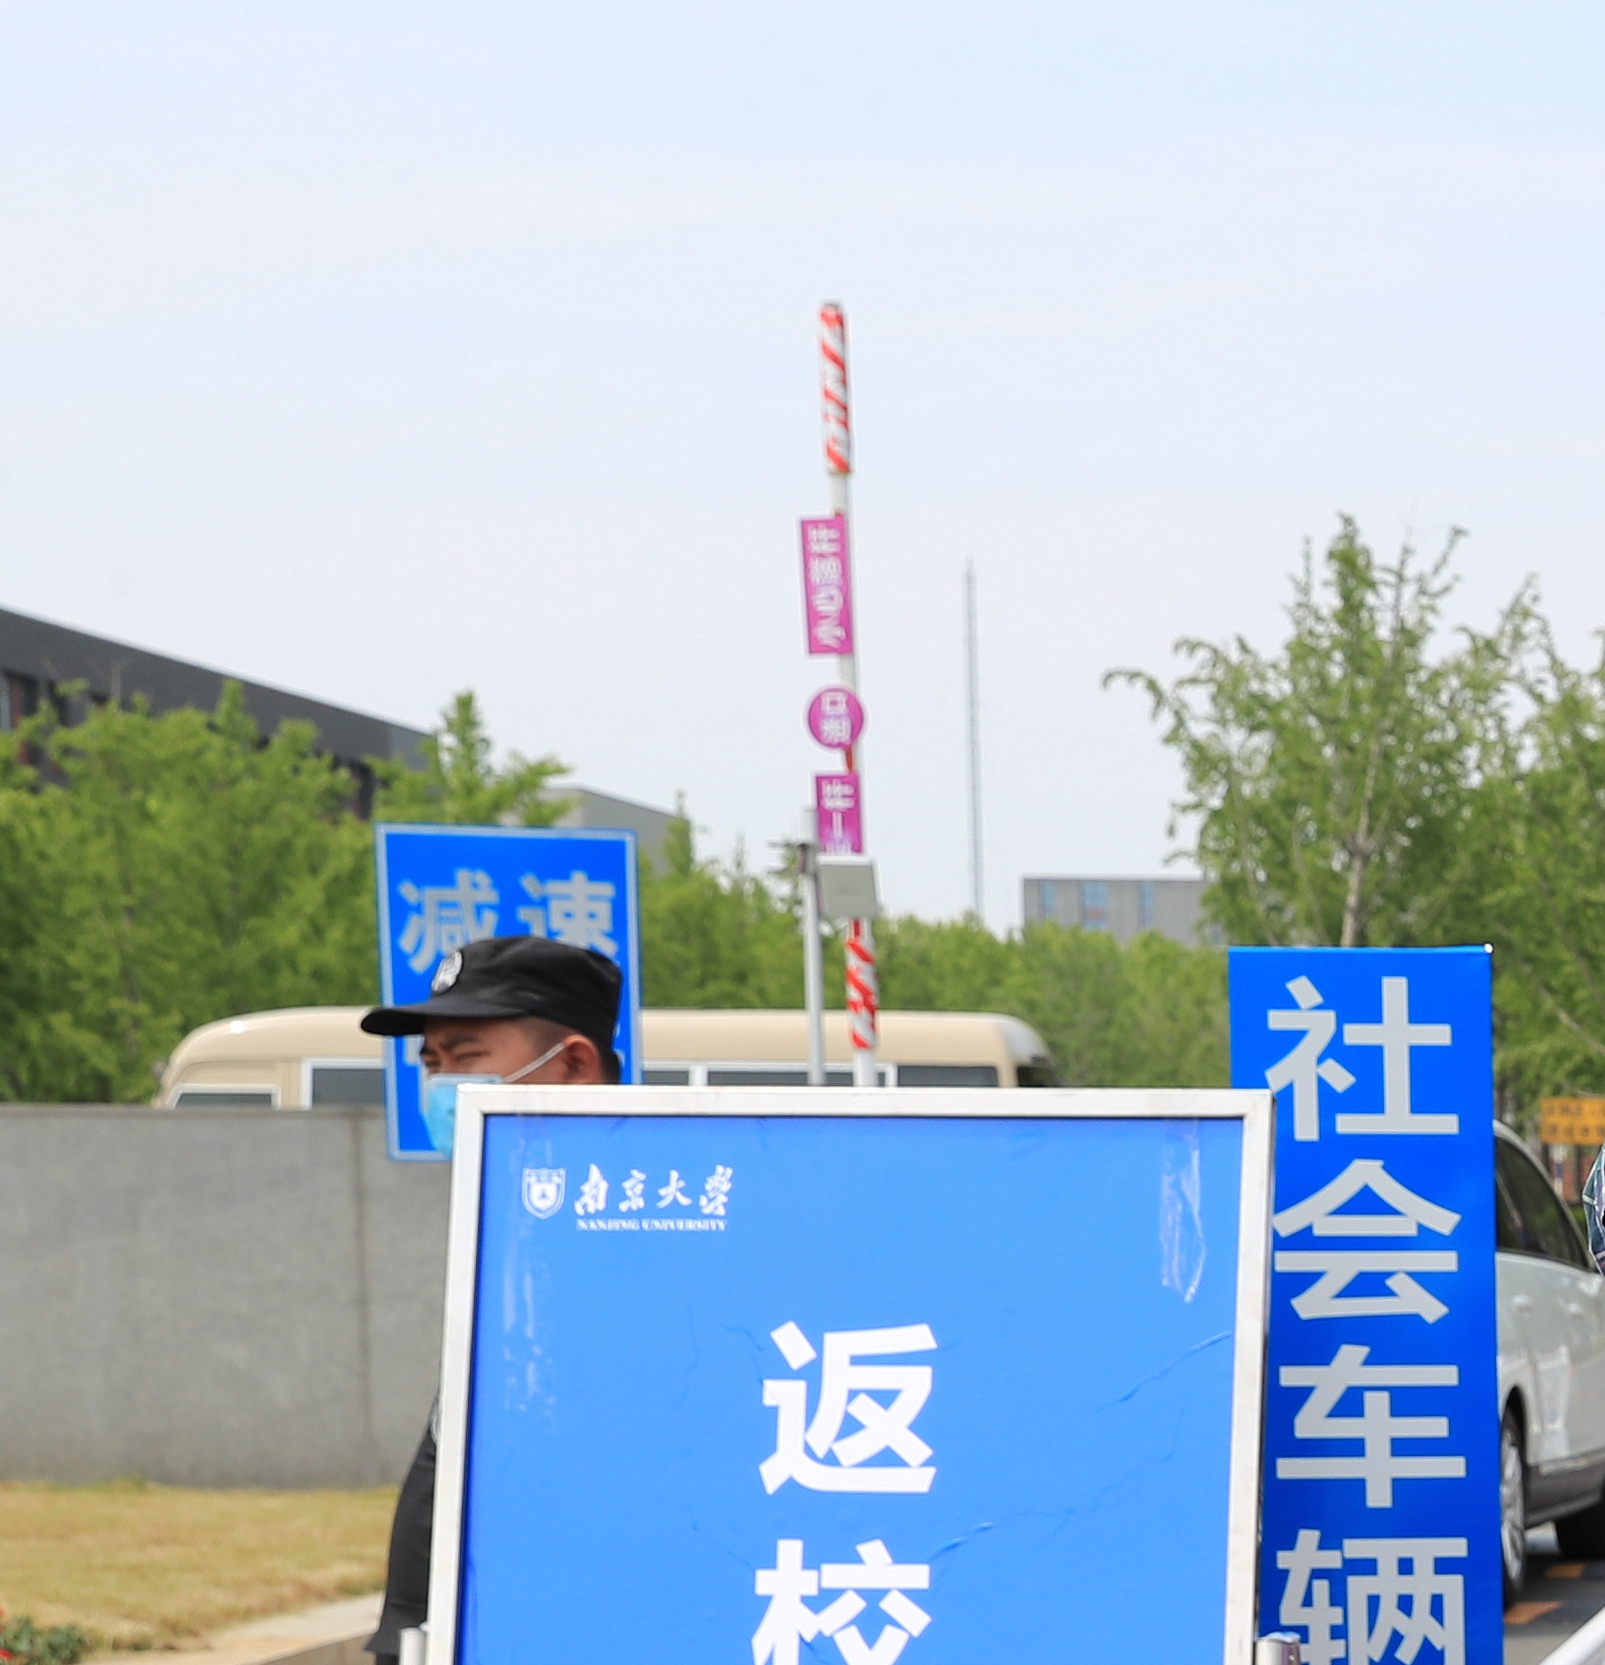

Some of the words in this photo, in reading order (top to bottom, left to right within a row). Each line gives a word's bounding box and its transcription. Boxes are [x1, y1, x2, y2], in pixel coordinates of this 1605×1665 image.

[398, 868, 620, 975] 减速
[576, 1218, 641, 1231] NANJING
[642, 1218, 728, 1231] UNIVERSITY
